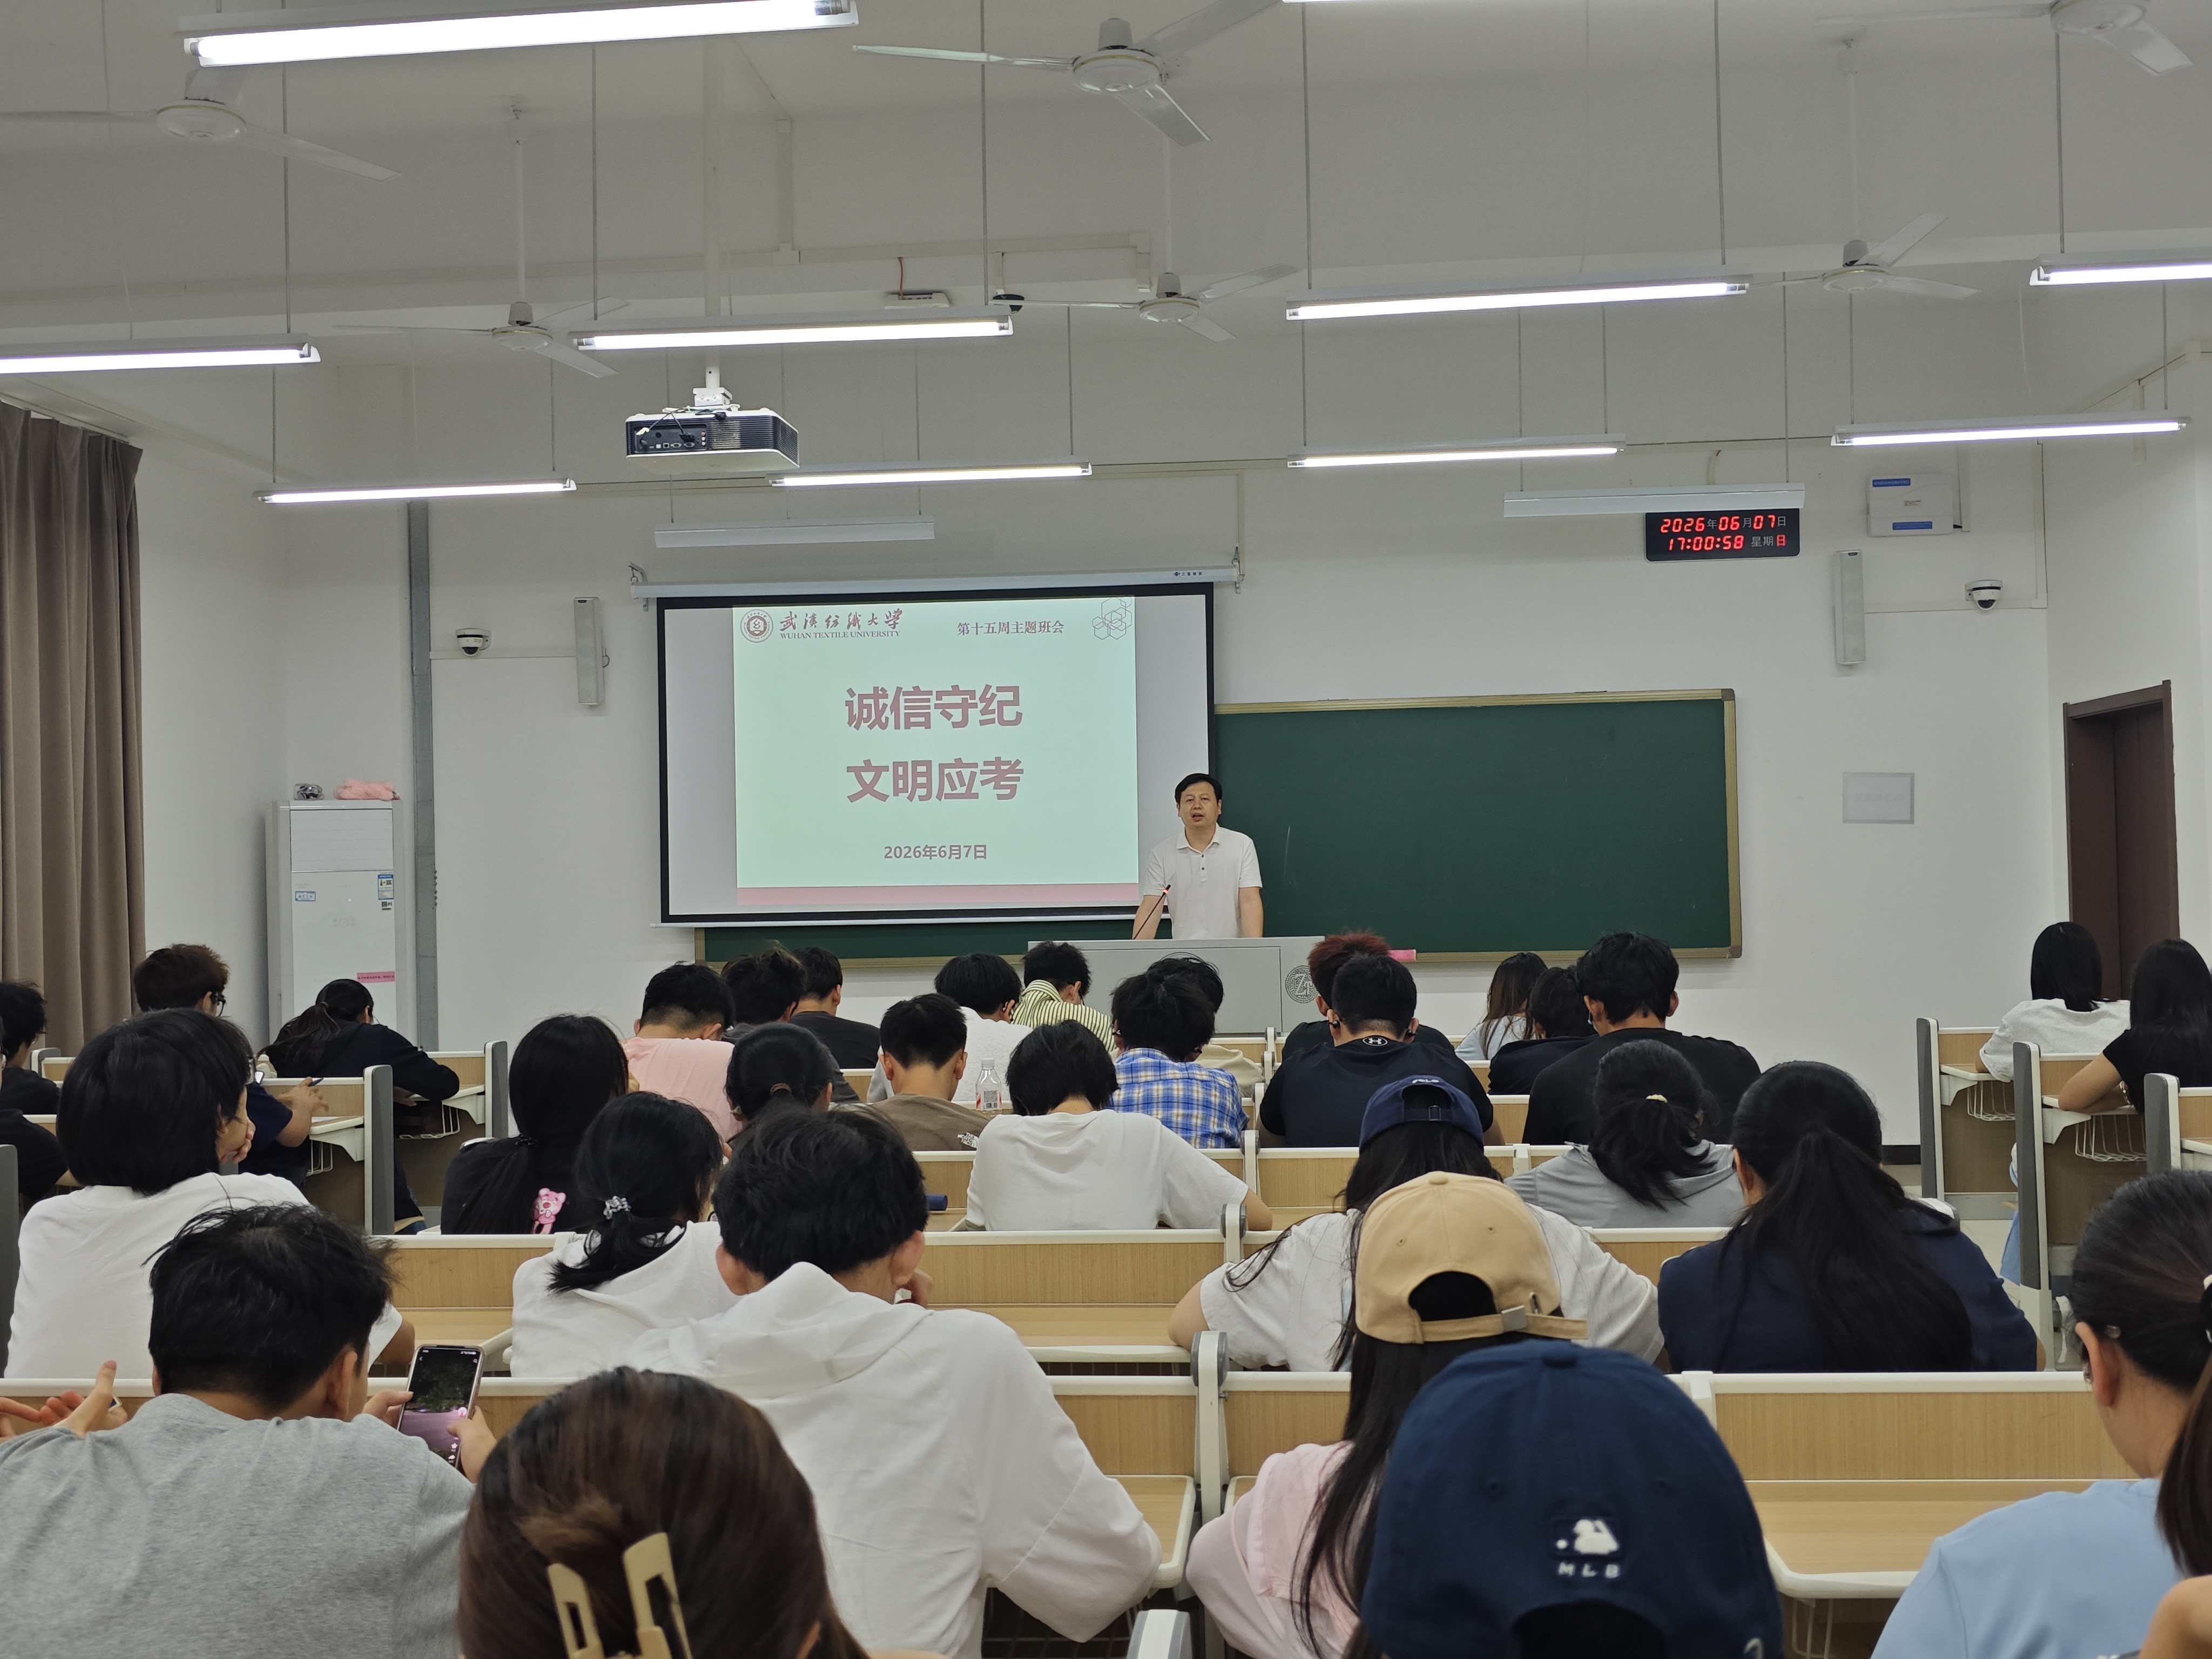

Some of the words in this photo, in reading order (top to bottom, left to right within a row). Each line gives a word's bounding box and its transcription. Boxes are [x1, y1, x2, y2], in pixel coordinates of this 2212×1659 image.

[1660, 515, 1786, 534] 2026年06月07日
[1668, 535, 1745, 551] 17:00:58
[957, 620, 1064, 636] 第十五周主题班会
[845, 684, 1023, 731] 诚信守纪
[846, 757, 1024, 803] 文明应考
[884, 844, 987, 860] 2026年6月7日
[1558, 1561, 1619, 1579] MLB
